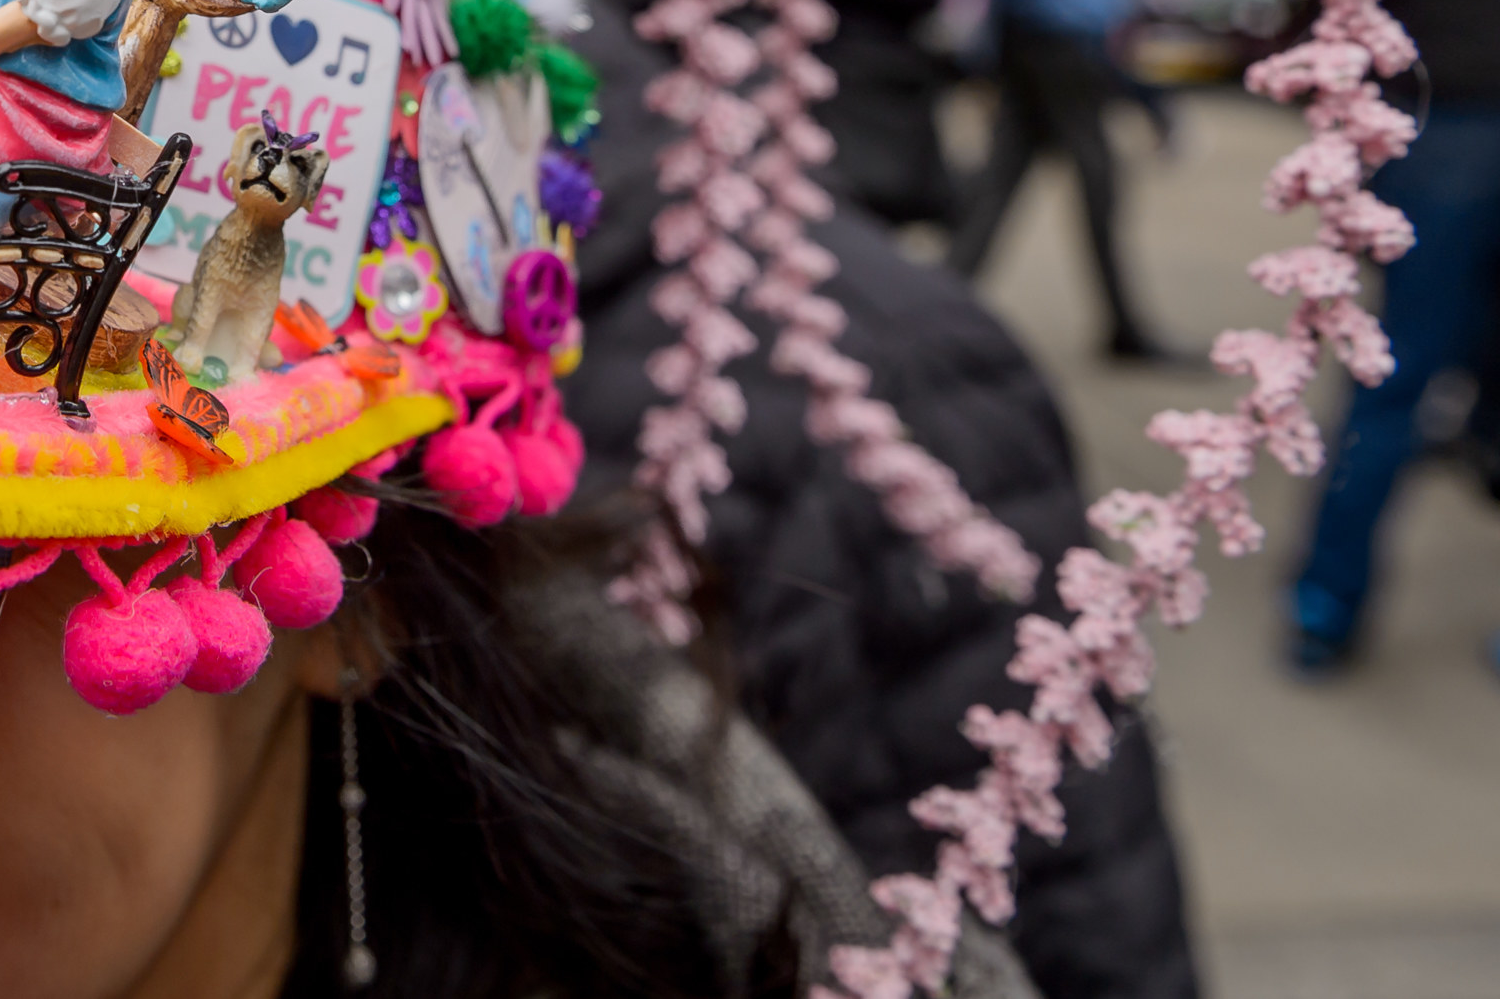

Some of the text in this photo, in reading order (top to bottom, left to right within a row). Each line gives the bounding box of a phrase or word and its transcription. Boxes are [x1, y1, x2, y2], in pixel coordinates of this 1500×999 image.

[191, 63, 363, 160] PEACE
[177, 144, 344, 230] LE
[170, 205, 332, 286] MIC
